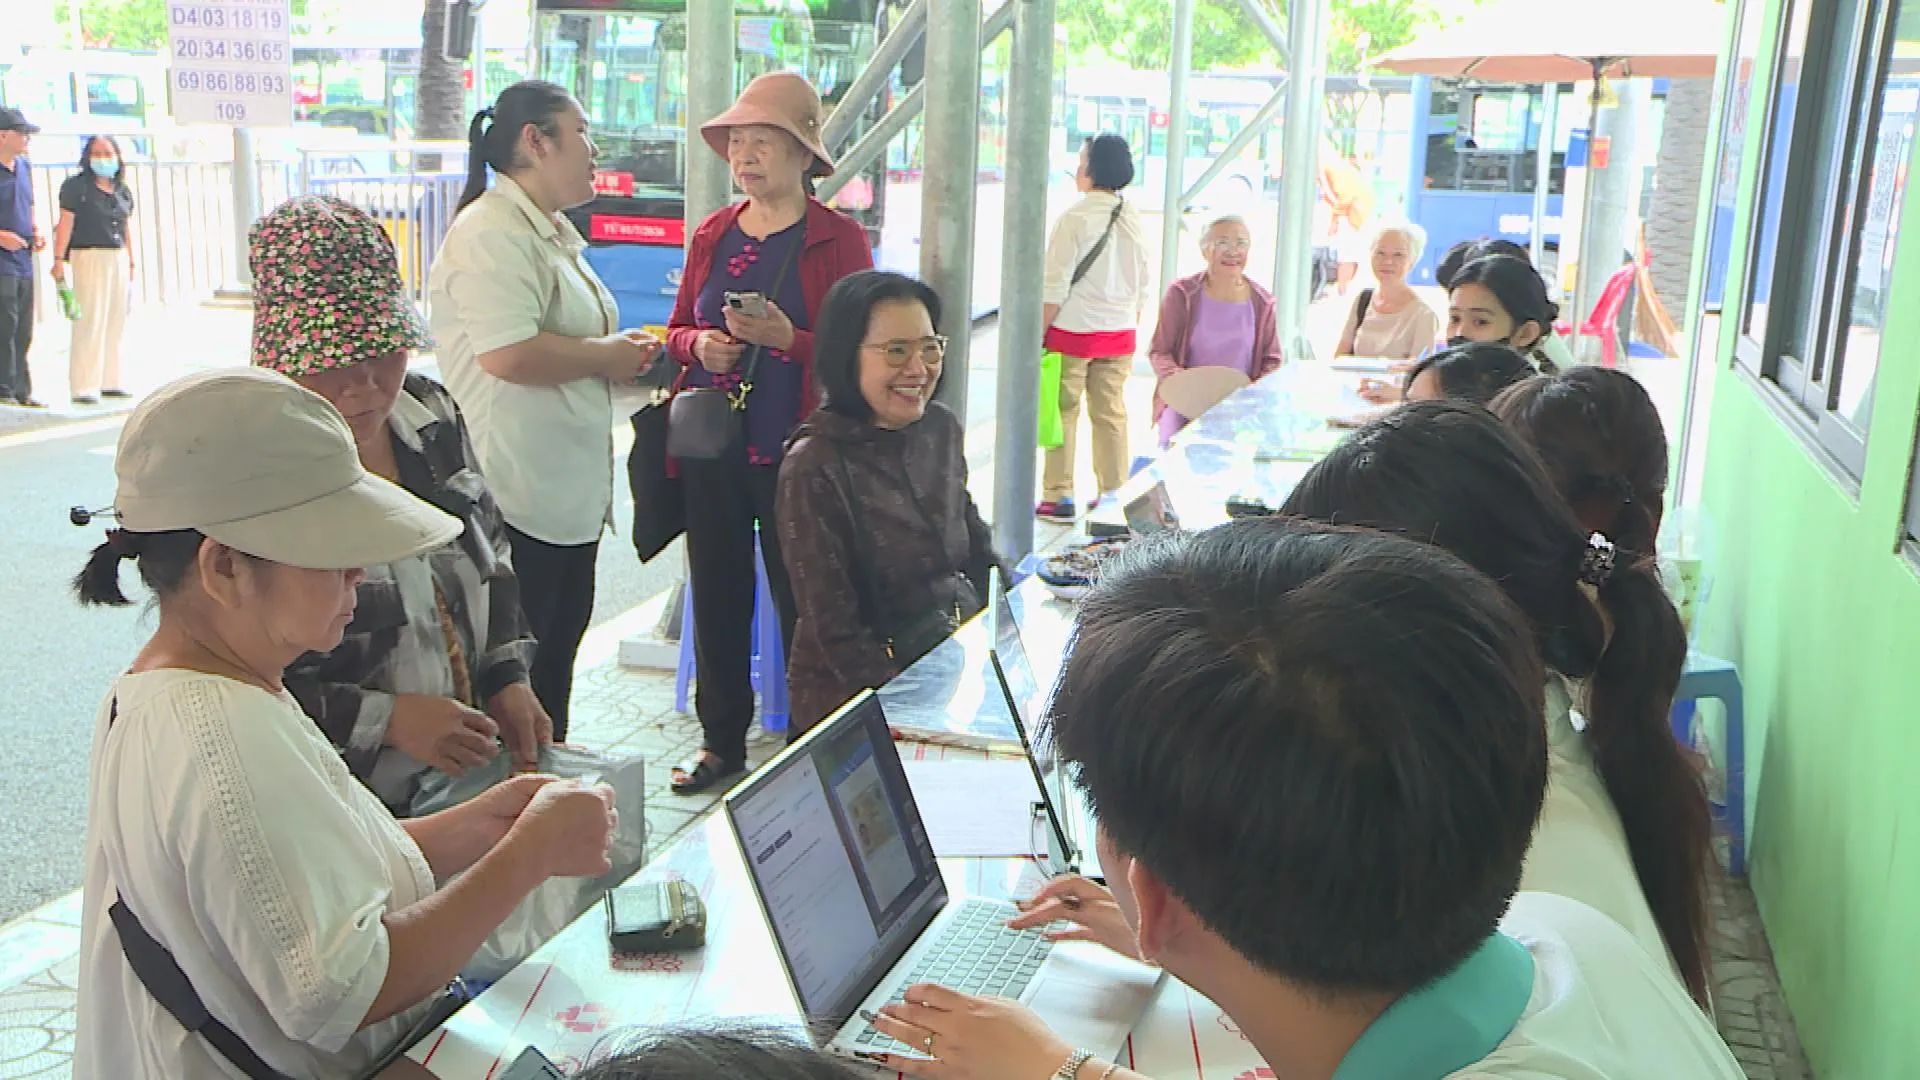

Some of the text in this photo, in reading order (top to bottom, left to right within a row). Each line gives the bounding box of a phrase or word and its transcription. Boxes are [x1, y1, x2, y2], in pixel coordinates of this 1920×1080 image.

[172, 7, 281, 29] D4 03 18 19
[176, 39, 283, 61] 20 34 36 65
[177, 71, 284, 94] 69 86 88 93
[216, 103, 245, 121] 109
